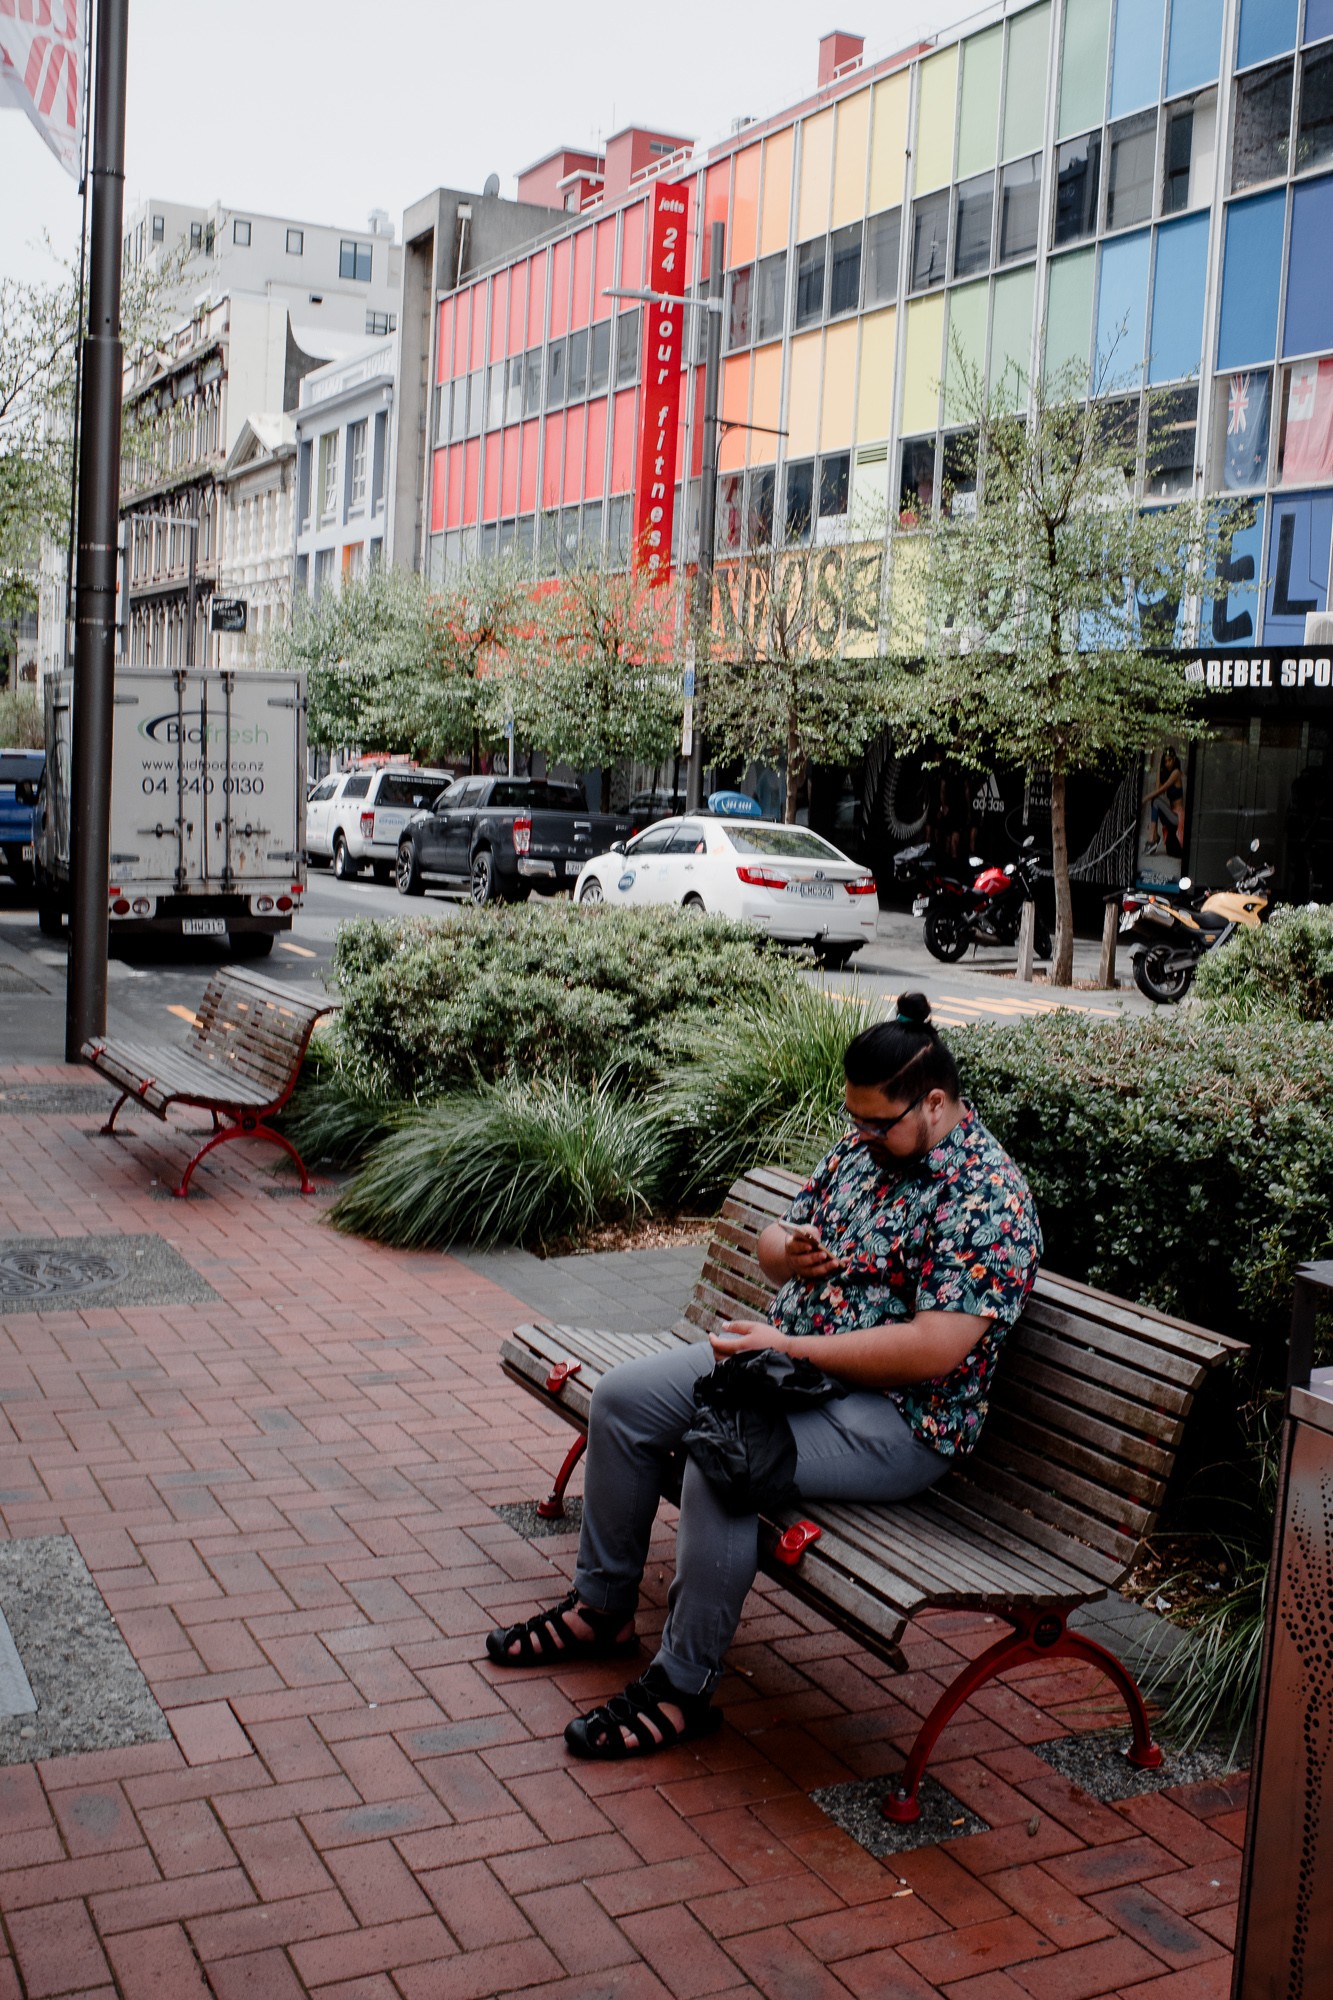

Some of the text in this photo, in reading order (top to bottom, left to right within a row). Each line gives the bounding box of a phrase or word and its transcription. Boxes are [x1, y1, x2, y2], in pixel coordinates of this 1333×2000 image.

[659, 197, 685, 214] jetts
[661, 227, 678, 274] 24
[649, 405, 669, 571] fitness
[1206, 658, 1333, 687] REBEL SPO
[142, 776, 264, 794] 04 240 0130
[972, 797, 1005, 812] addas
